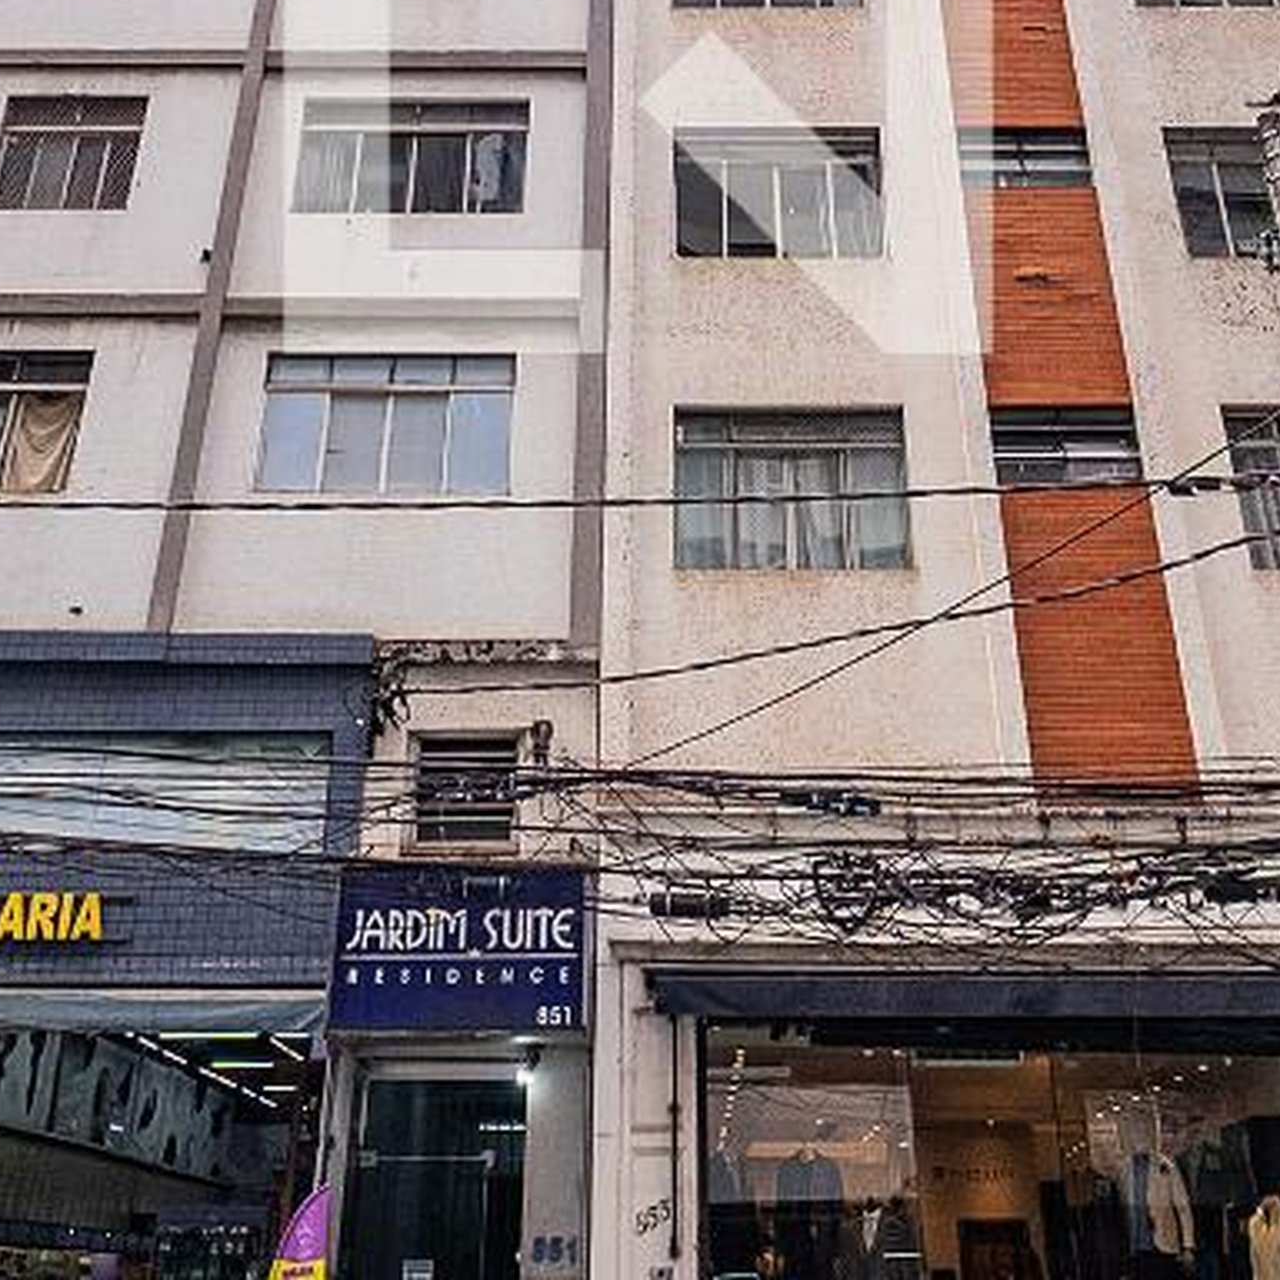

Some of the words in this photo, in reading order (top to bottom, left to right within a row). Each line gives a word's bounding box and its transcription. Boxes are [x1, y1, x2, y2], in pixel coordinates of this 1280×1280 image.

[346, 907, 468, 950] JARDIM
[483, 907, 575, 950] SUITE
[346, 967, 570, 985] RESIDENCE
[535, 1005, 573, 1025] 851
